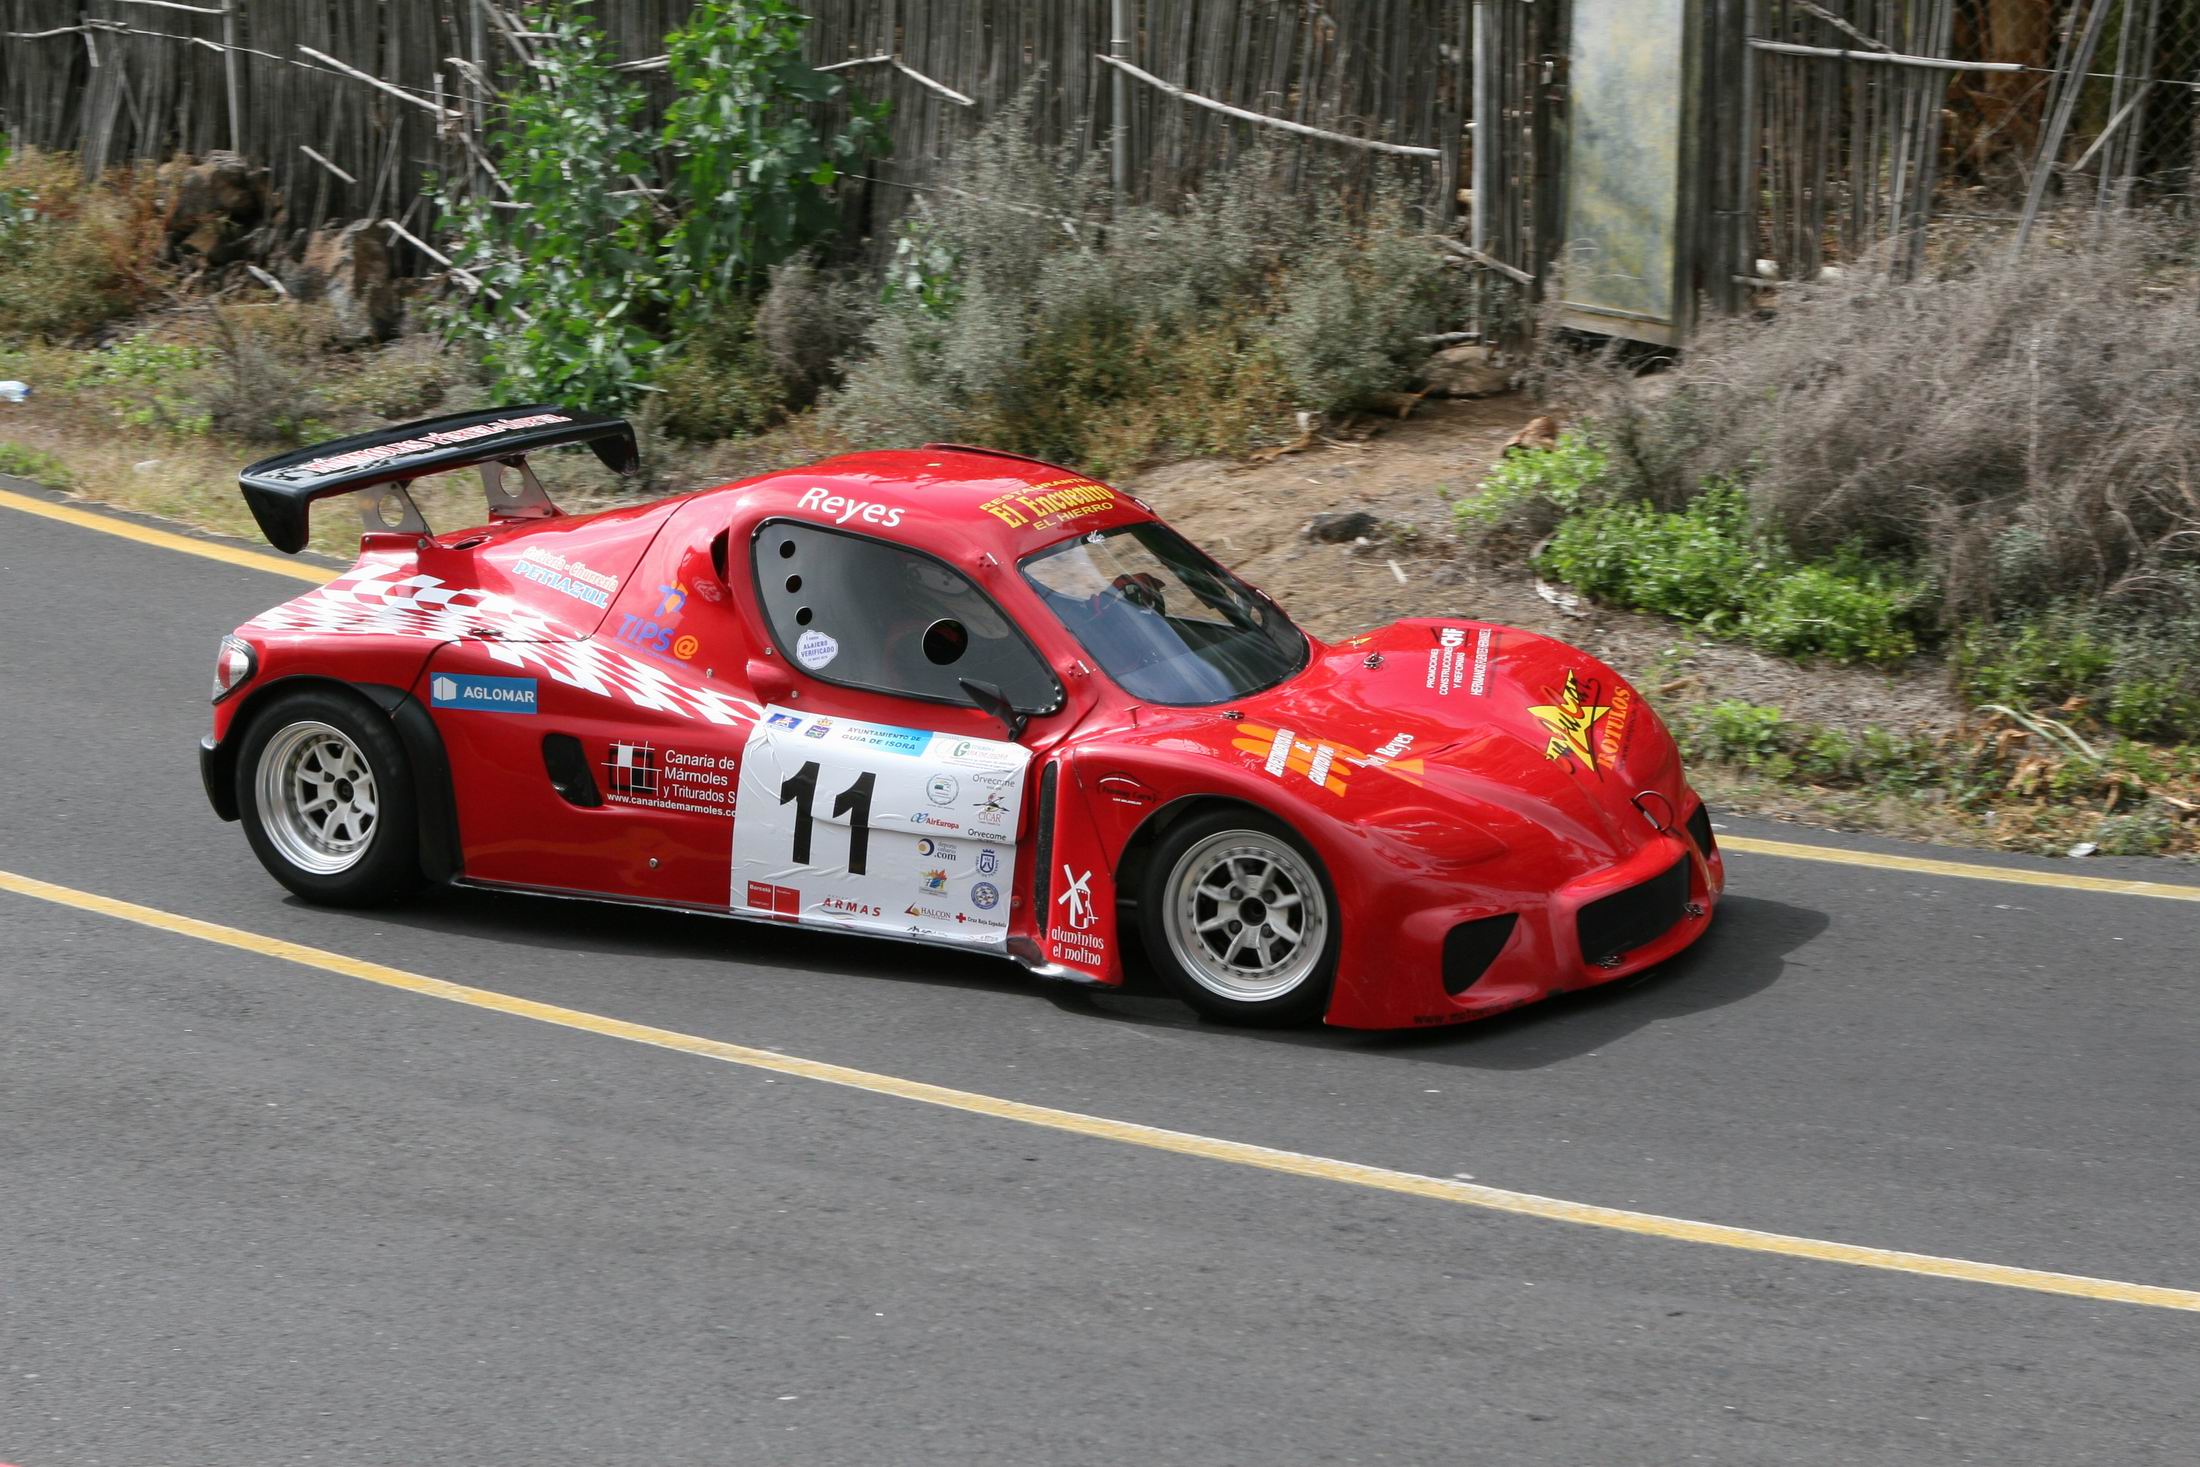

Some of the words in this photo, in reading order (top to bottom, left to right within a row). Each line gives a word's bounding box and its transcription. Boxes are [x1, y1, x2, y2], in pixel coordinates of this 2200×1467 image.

[979, 478, 1090, 511] RESTAURANTE
[797, 487, 906, 528] Reyes
[988, 503, 1029, 529] El
[1016, 484, 1115, 518] Encuentro
[1033, 520, 1056, 531] EL
[1057, 502, 1114, 522] HIERRO
[616, 612, 676, 652] TIPS
[801, 646, 835, 658] VERIFICADO
[463, 686, 535, 703] AGLOMAR
[847, 726, 909, 741] AYUNTAMIENTO
[869, 738, 883, 746] DE
[885, 740, 916, 750] ISORA
[1375, 732, 1415, 758] Reyes
[665, 750, 715, 768] Canaria
[718, 756, 735, 770] de
[664, 766, 728, 786] Mármoles
[663, 785, 670, 798] y
[672, 784, 725, 803] Triturados
[779, 760, 877, 876] 11
[822, 898, 881, 916] ARMAS
[1051, 926, 1104, 950] aluminios
[1052, 943, 1061, 957] el
[1065, 947, 1101, 966] molino
